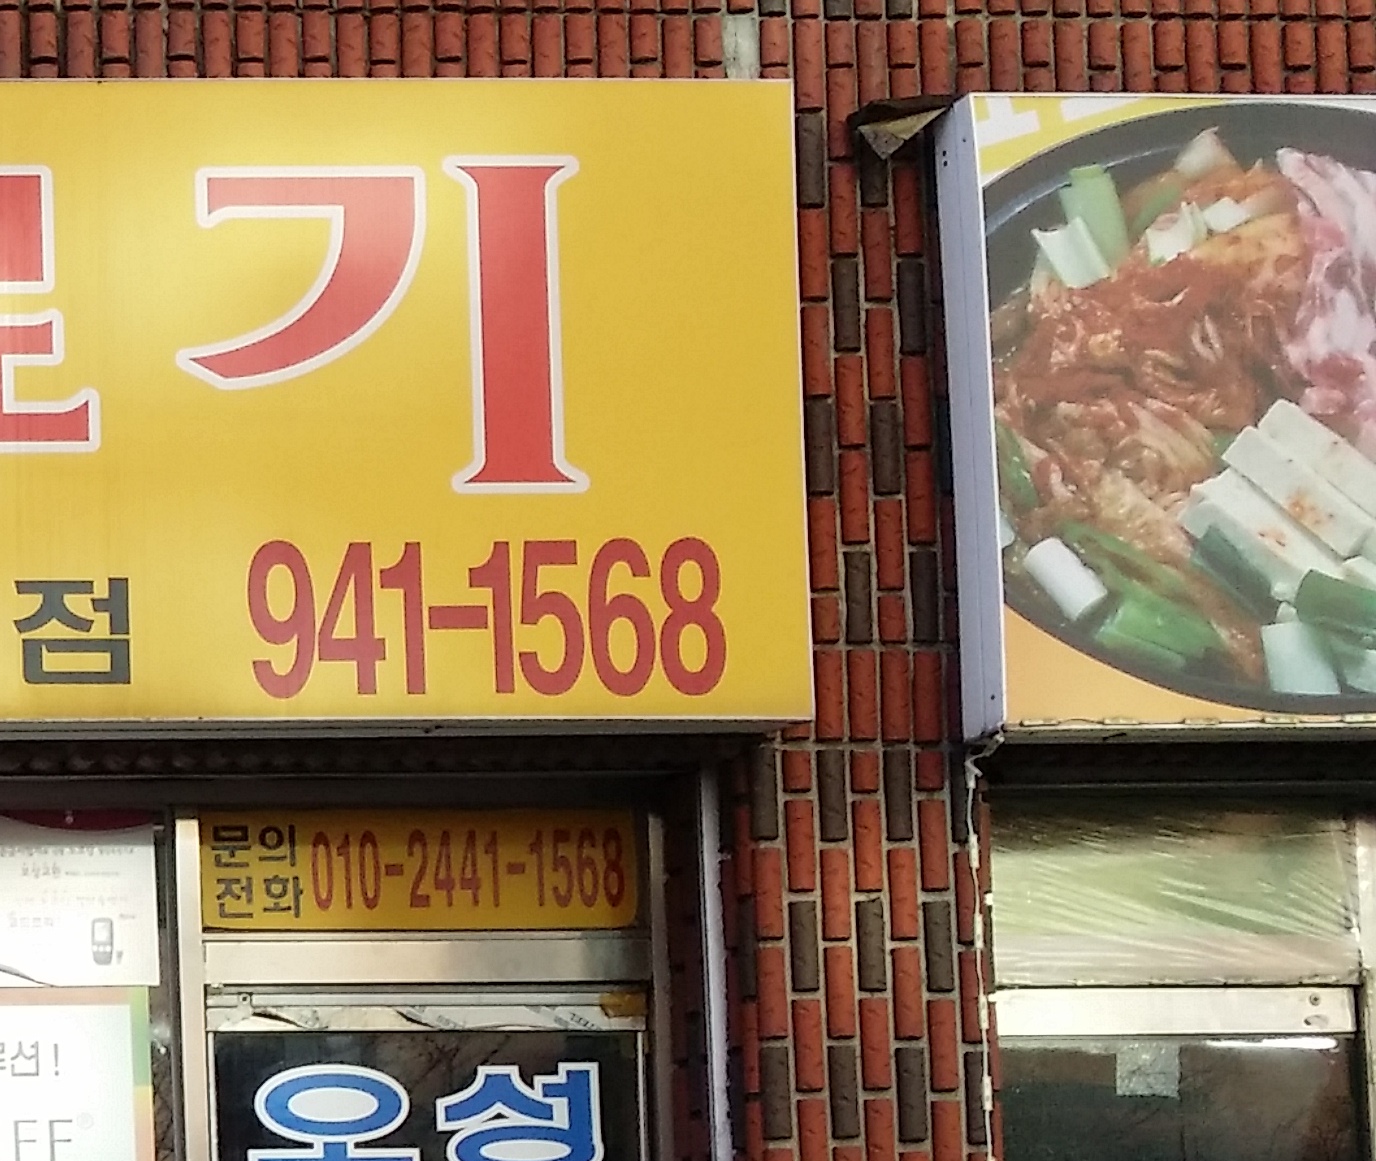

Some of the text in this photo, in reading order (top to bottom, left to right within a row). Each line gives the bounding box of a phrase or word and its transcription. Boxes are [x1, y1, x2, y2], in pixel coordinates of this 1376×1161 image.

[249, 538, 727, 698] 941-1568
[211, 823, 298, 868] 문의
[311, 827, 627, 911] 010-2441-1568
[215, 875, 303, 919] 전화
